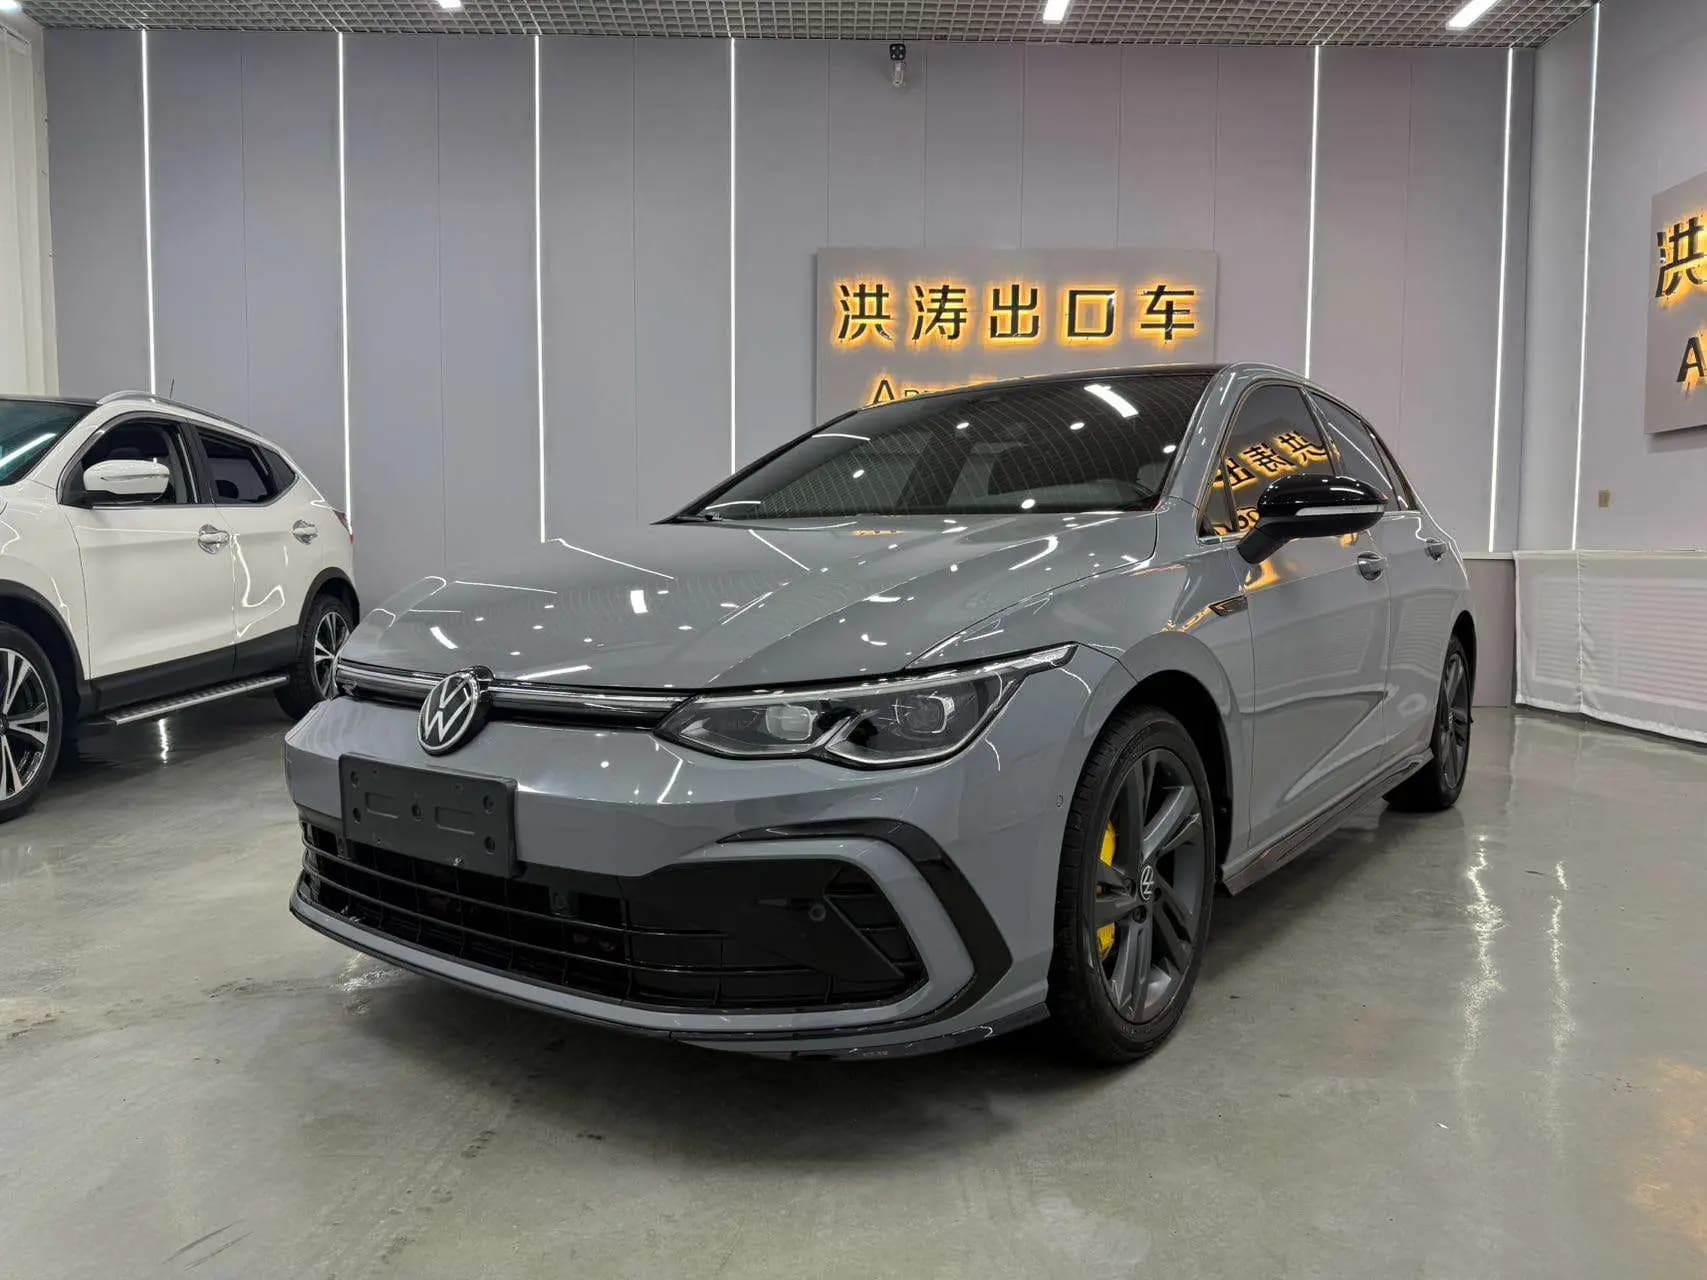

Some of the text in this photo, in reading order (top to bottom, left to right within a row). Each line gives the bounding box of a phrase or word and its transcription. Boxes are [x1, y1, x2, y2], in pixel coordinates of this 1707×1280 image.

[838, 284, 1195, 341] 洪涛出口车
[423, 676, 471, 743] VW
